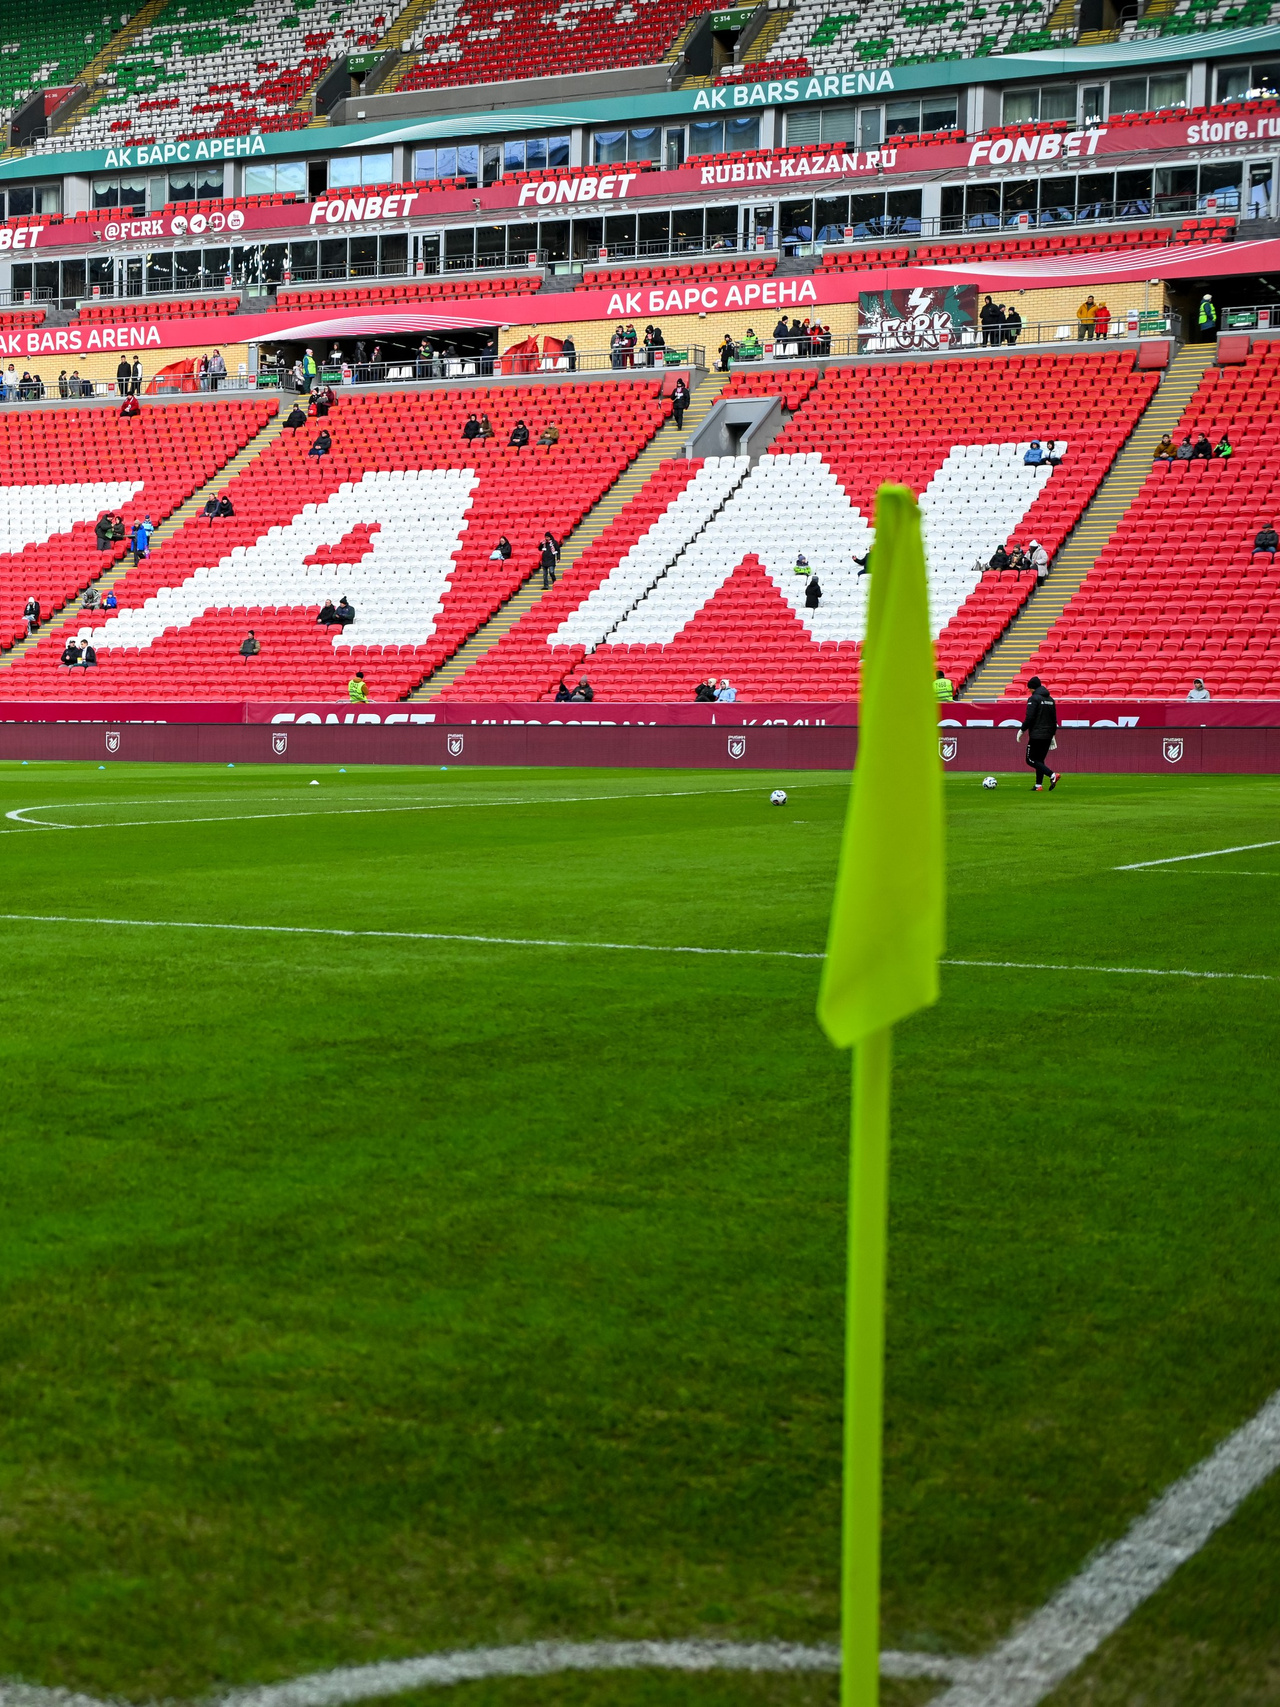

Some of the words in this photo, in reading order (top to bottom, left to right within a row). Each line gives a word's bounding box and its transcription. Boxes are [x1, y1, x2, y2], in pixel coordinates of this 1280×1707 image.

[693, 87, 727, 110] AK
[733, 80, 800, 107] BARS
[805, 69, 895, 99] ARENA
[104, 147, 132, 168] АК
[137, 142, 191, 165] БАРС
[195, 135, 266, 160] АРЕНА
[967, 129, 1107, 167] FONBET
[700, 149, 898, 184] RUBIN-KAZAN.RU
[518, 173, 636, 206] FONBET
[309, 193, 419, 225] FONBET
[104, 219, 164, 241] @FCRK
[606, 291, 642, 315] АК
[649, 286, 718, 312] БАРС
[725, 279, 817, 308] АРЕНА
[27, 331, 82, 352] BARS
[87, 326, 161, 348] ARENA
